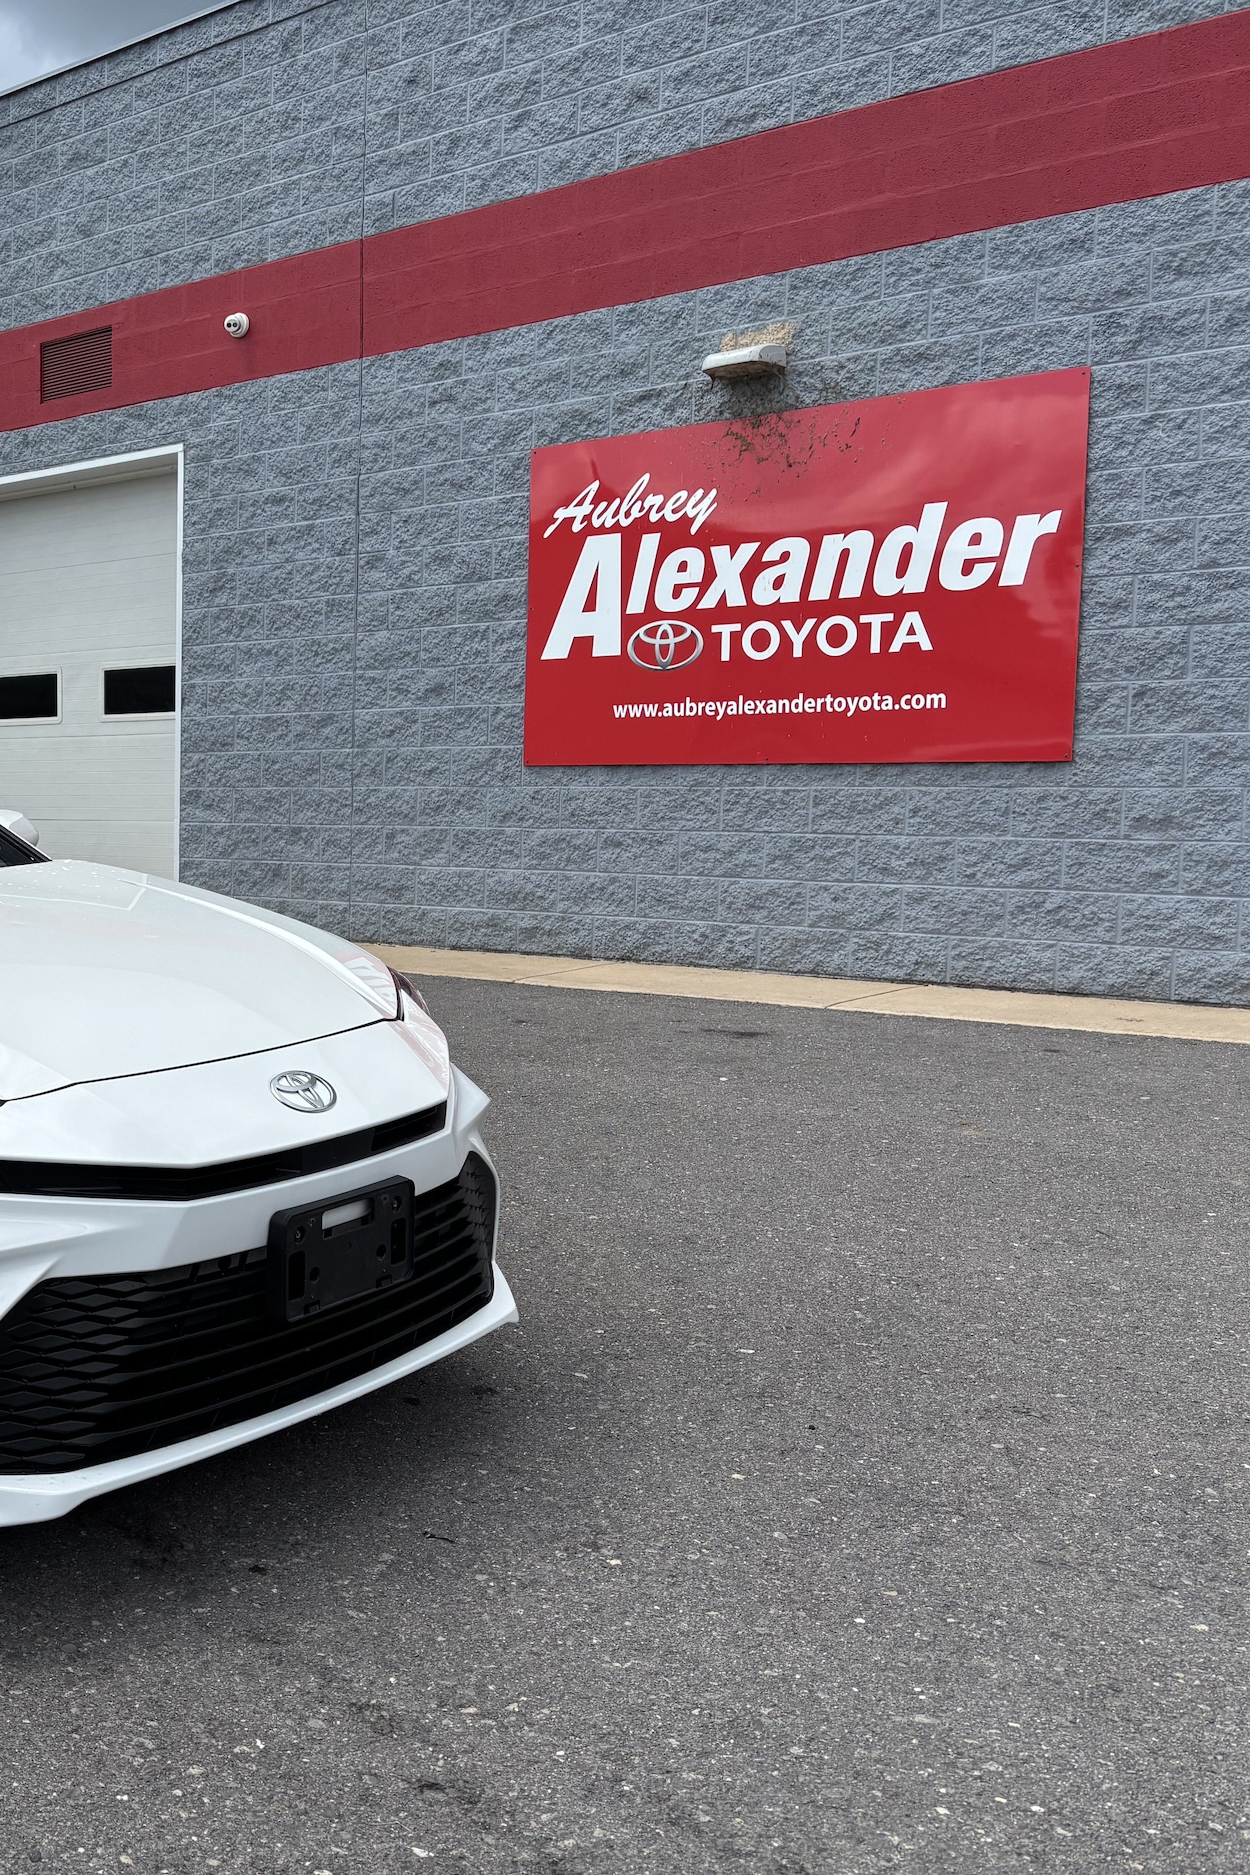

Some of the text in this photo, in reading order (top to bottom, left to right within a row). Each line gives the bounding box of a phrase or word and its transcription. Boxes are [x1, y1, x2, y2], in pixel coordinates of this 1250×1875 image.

[543, 472, 717, 539] Aubrey
[540, 501, 1062, 661] Alexander
[711, 611, 934, 662] TOYOTA
[612, 691, 947, 721] www.aubreyalexandertoyota.com
